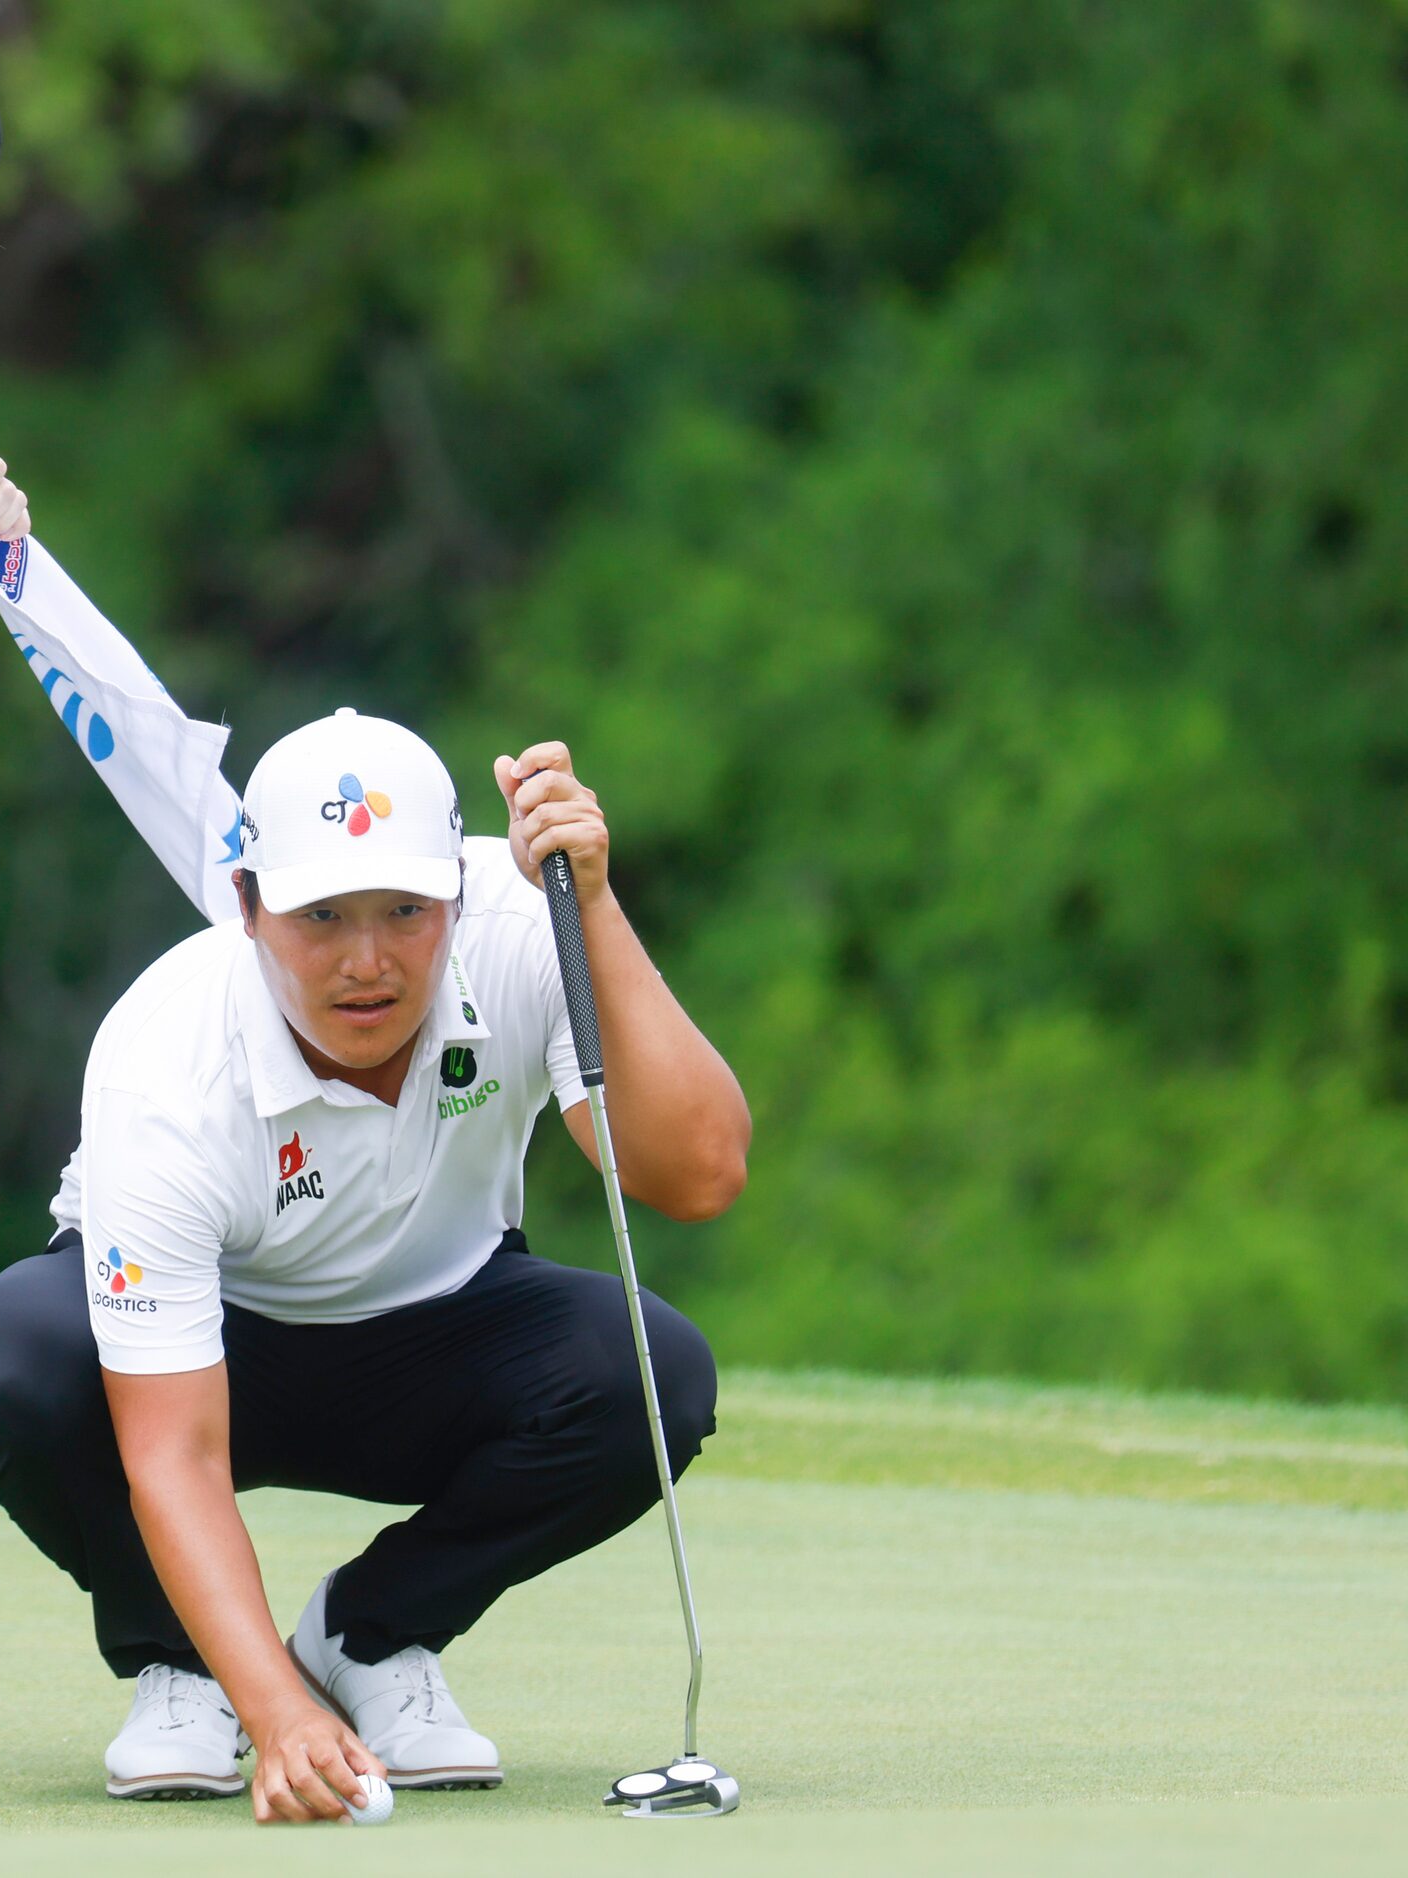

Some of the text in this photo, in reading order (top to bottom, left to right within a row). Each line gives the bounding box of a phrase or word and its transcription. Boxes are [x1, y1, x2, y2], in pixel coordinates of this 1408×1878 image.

[320, 800, 348, 824] CJ
[554, 849, 568, 892] SEY
[438, 1079, 501, 1120] bibigo
[276, 1170, 324, 1217] NAAC
[97, 1261, 111, 1281] CJ
[92, 1291, 157, 1313] LOGISTICS
